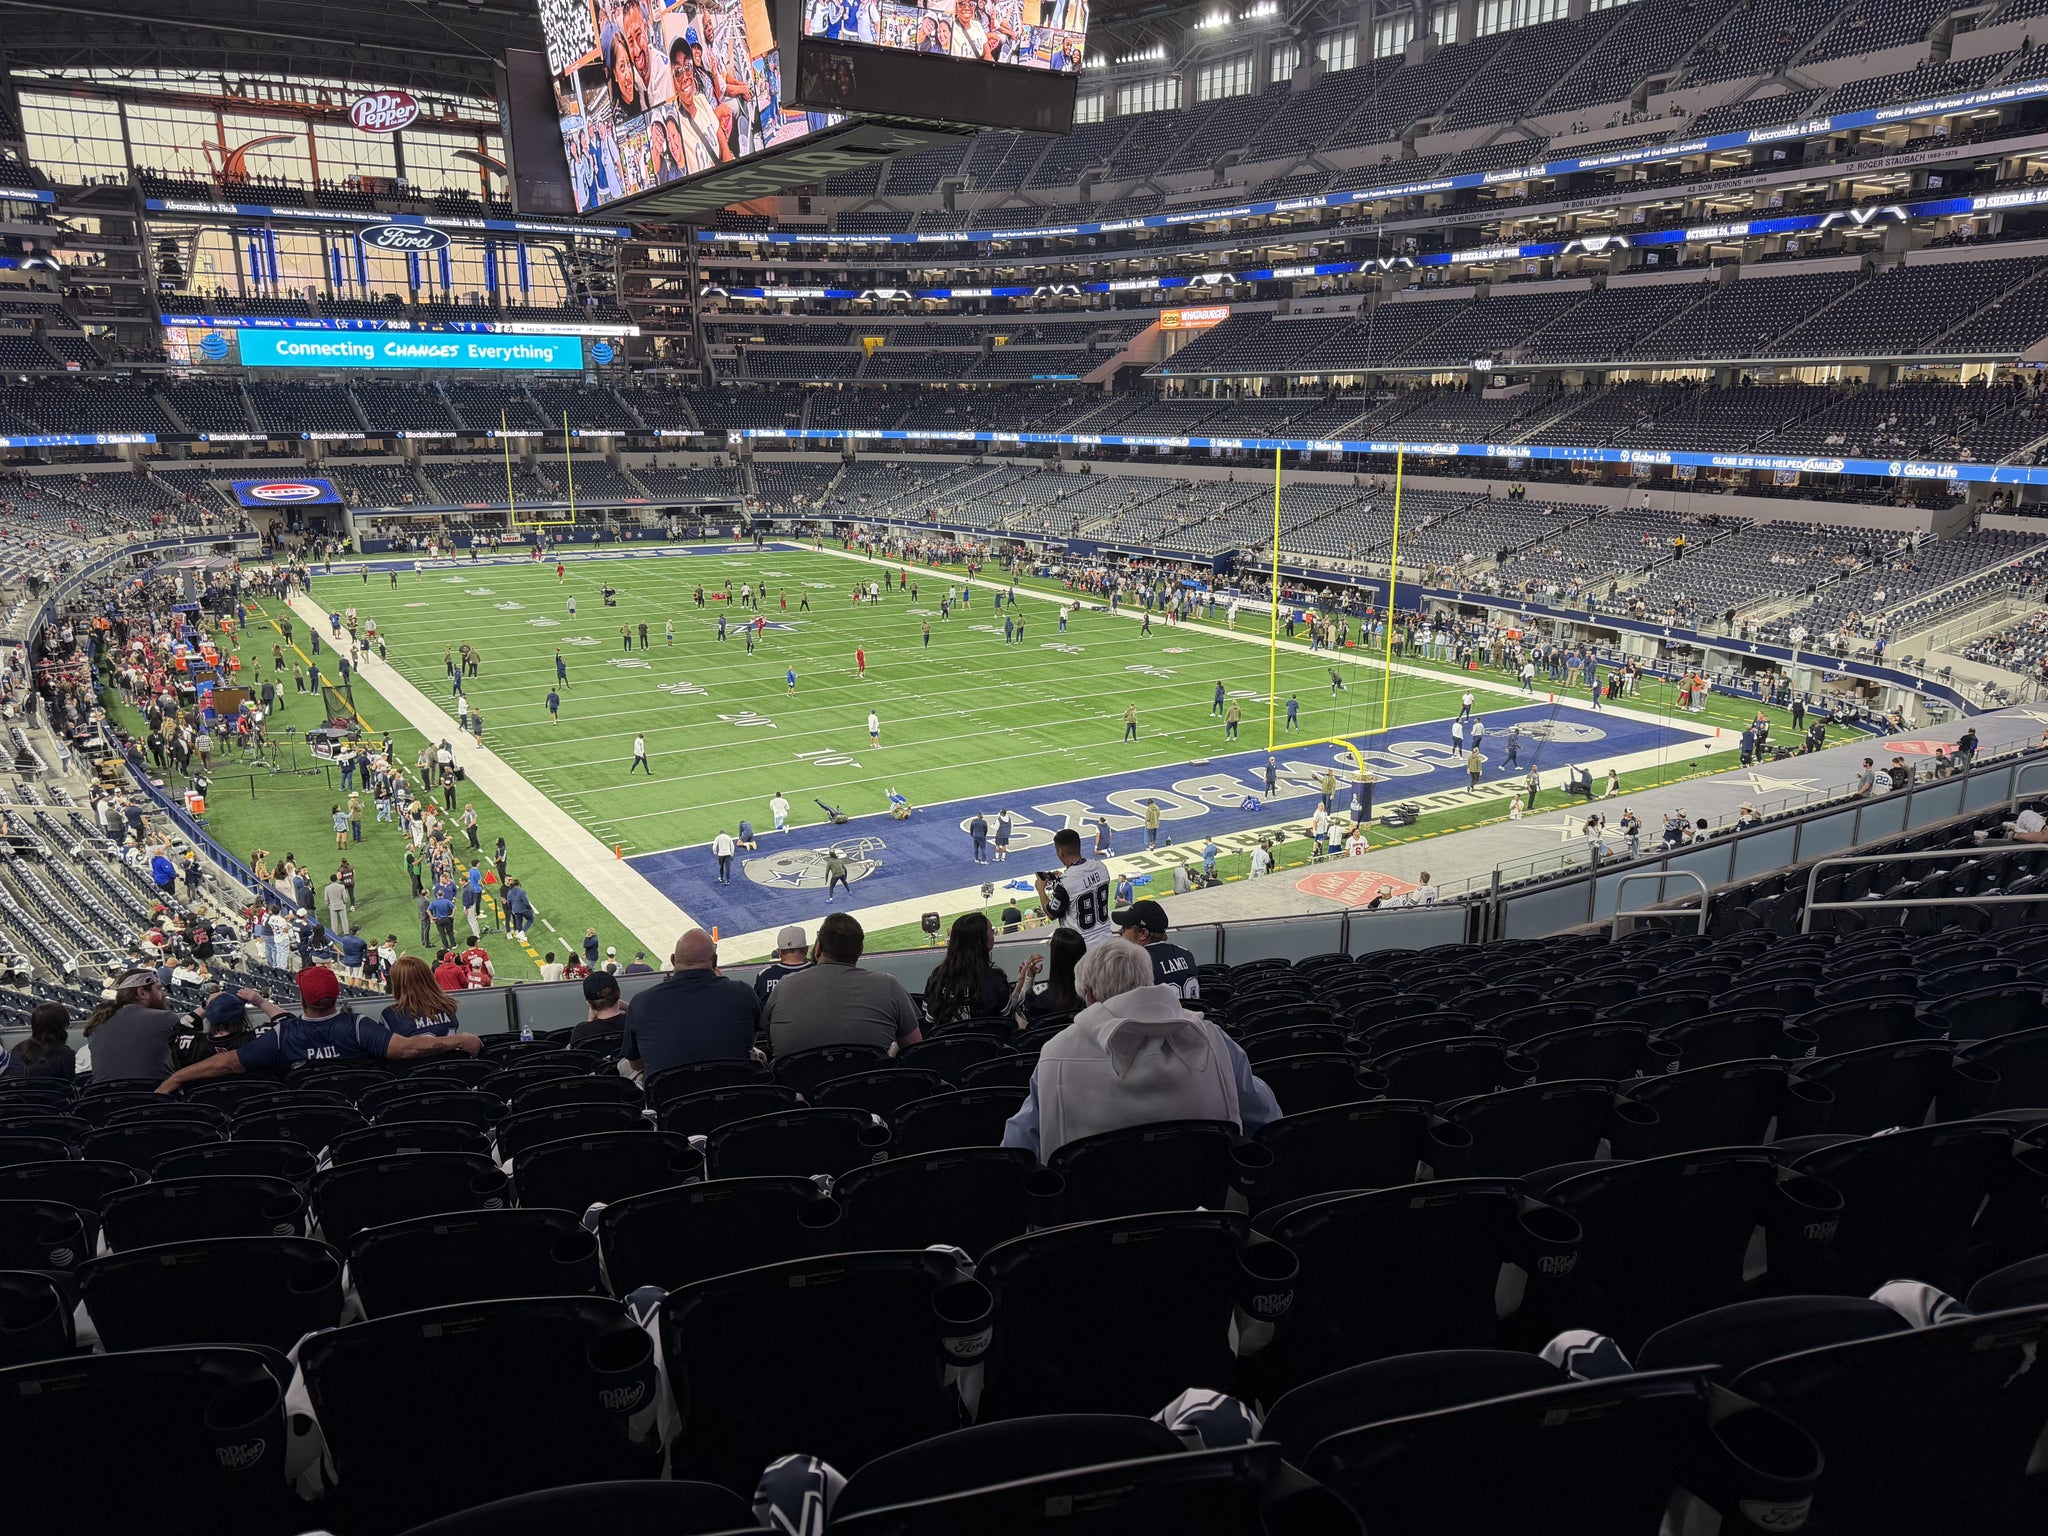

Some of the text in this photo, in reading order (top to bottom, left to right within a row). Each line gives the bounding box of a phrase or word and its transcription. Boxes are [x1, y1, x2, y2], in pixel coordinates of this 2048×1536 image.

[376, 95, 401, 113] Dr
[1876, 110, 1903, 120] Official
[1904, 105, 1934, 115] Fashion
[1935, 100, 1964, 111] Partner
[1965, 97, 1975, 105] of
[1976, 94, 1989, 103] the
[1990, 89, 2015, 100] Dallas
[358, 98, 415, 128] Pepper
[1747, 119, 1830, 143] Abercrombie & Fitch
[1857, 160, 1883, 170] ROGER
[1885, 153, 1925, 166] STAUBACH
[1483, 168, 1523, 183] Abercrombie
[1529, 166, 1546, 177] Fitch
[1687, 185, 1695, 193] 43
[1698, 183, 1712, 191] DON
[1714, 179, 1741, 190] PERKINS
[1458, 213, 1484, 222] MEREDITH
[377, 226, 435, 249] Ford
[1181, 309, 1227, 321] WHATABURGER
[255, 319, 281, 327] American
[295, 320, 321, 328] American
[388, 321, 410, 330] 90:00
[276, 340, 374, 359] Connecting
[384, 341, 460, 357] CHANGES
[108, 435, 131, 443] Globe
[132, 435, 146, 443] Life
[209, 433, 268, 441] Blockchain.com
[310, 432, 365, 440] Blockchain.com
[1496, 446, 1530, 457] Globe Life
[1631, 451, 1671, 463] Globe Life
[1712, 456, 1842, 470] GLOBE LIFE HAS HELPED FAMILIES
[1904, 464, 1958, 478] Globe Life
[256, 488, 316, 496] PEPSI
[717, 711, 770, 728] 20
[792, 747, 855, 768] 10
[1083, 873, 1101, 889] LAMB
[1076, 883, 1110, 931] 88
[1160, 957, 1189, 975] LAMB
[307, 1046, 340, 1060] PAUL
